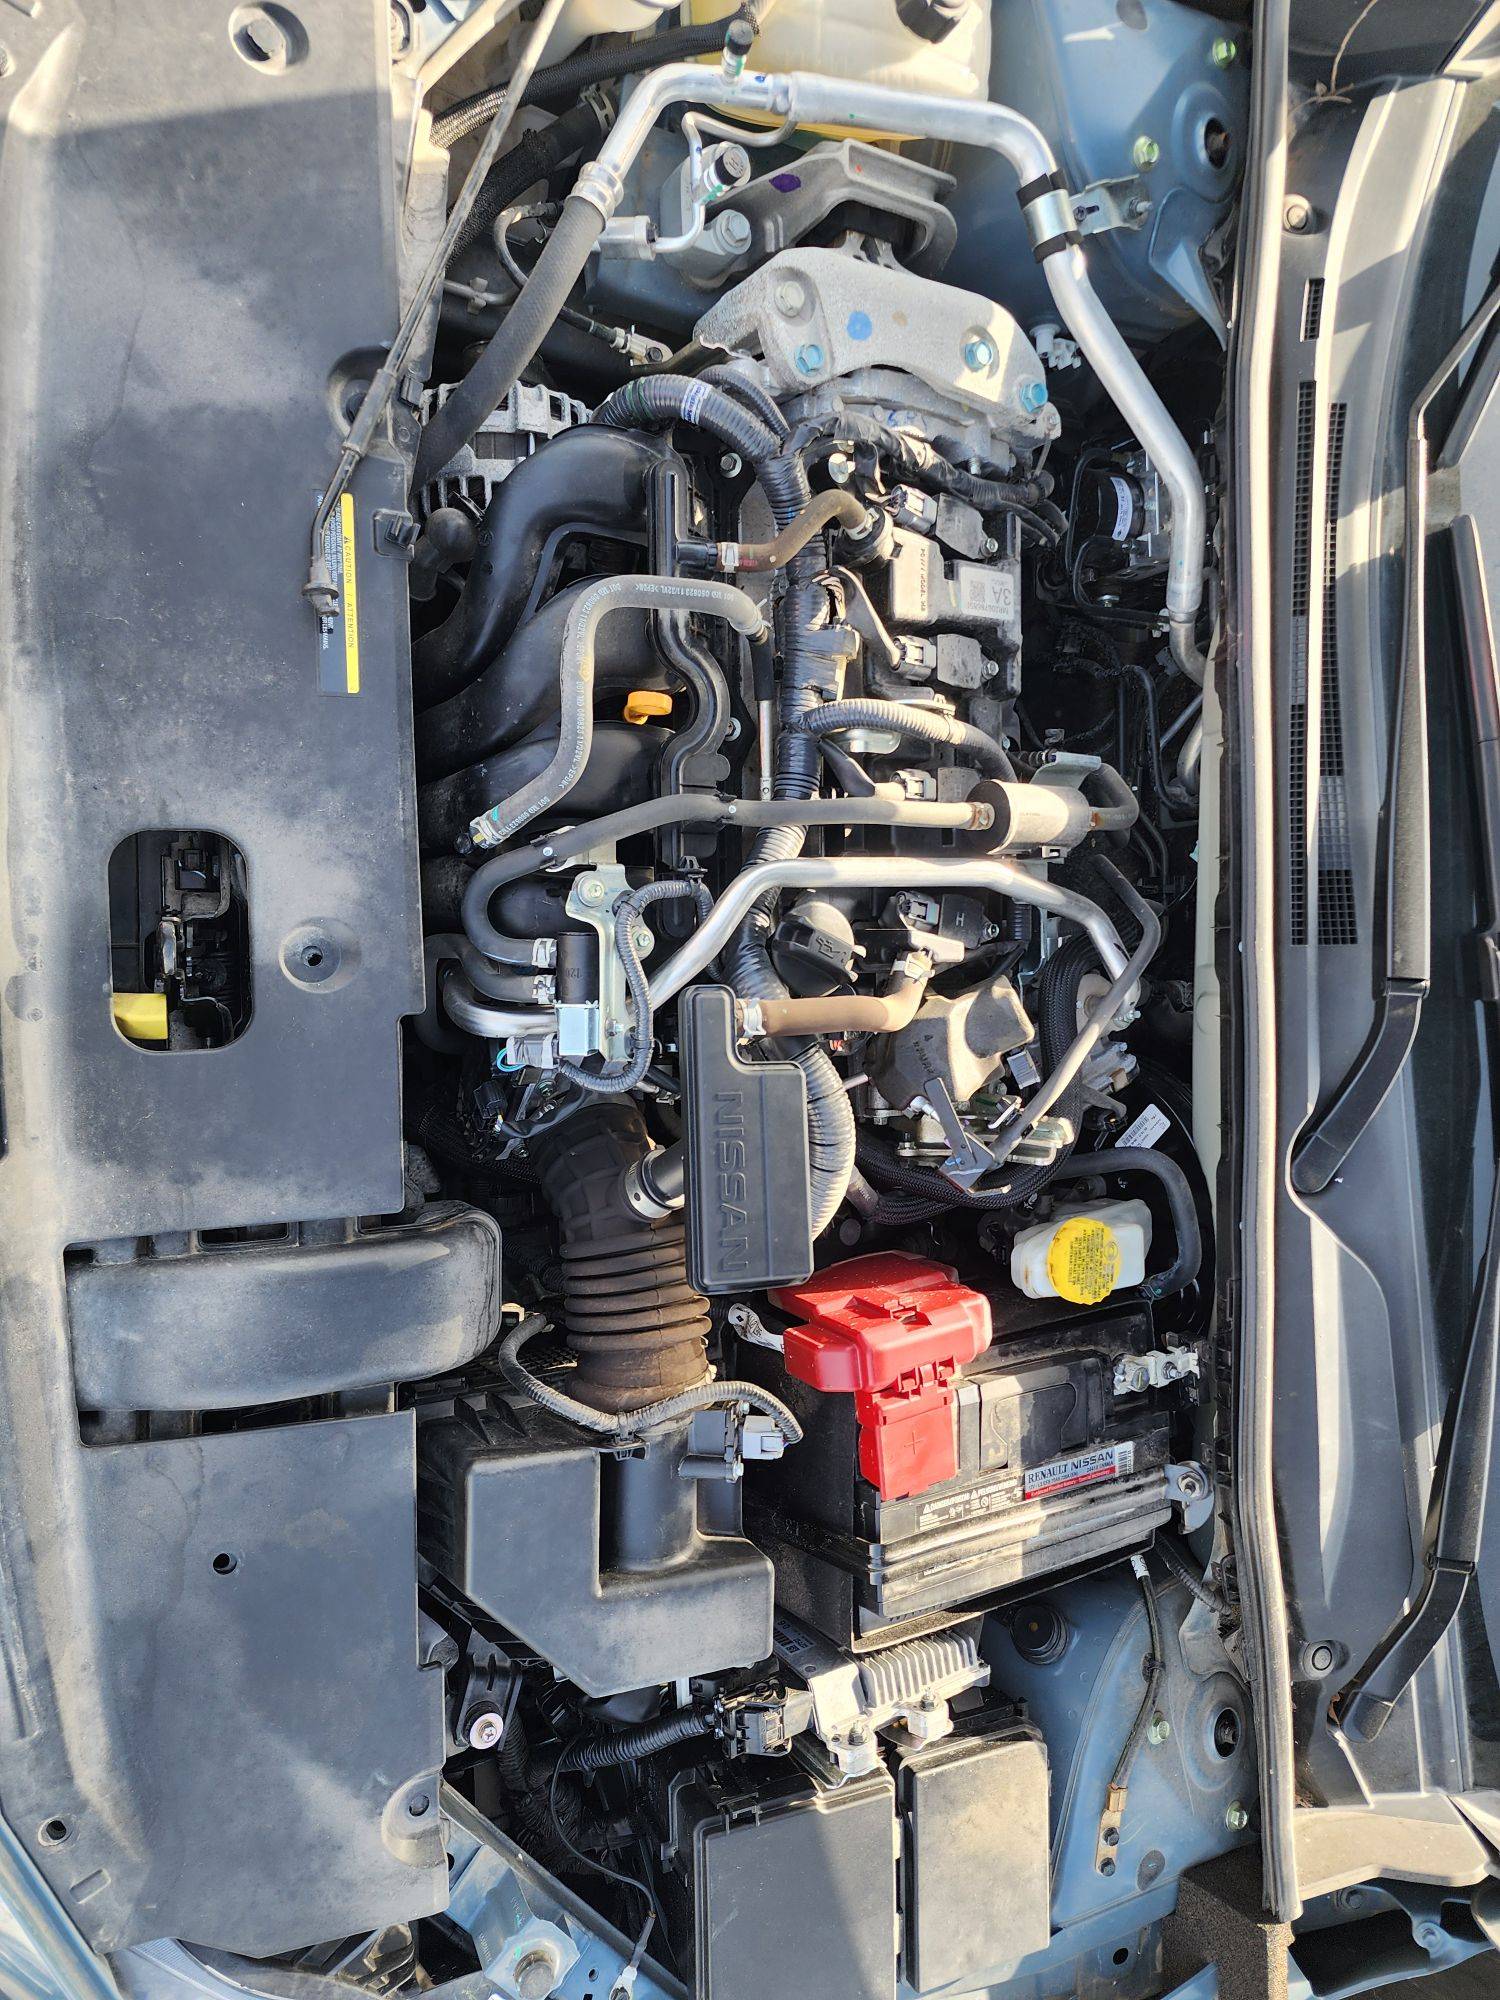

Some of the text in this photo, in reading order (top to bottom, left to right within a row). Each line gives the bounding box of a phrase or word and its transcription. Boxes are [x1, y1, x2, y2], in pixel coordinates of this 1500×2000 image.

[344, 546, 352, 584] CAUTION
[992, 586, 1011, 606] 3A
[346, 602, 354, 648] ATTENTION
[955, 911, 965, 927] H
[713, 1090, 748, 1273] NISSAN
[1028, 1464, 1068, 1483] RENAULT
[1071, 1451, 1114, 1470] NISSAN
